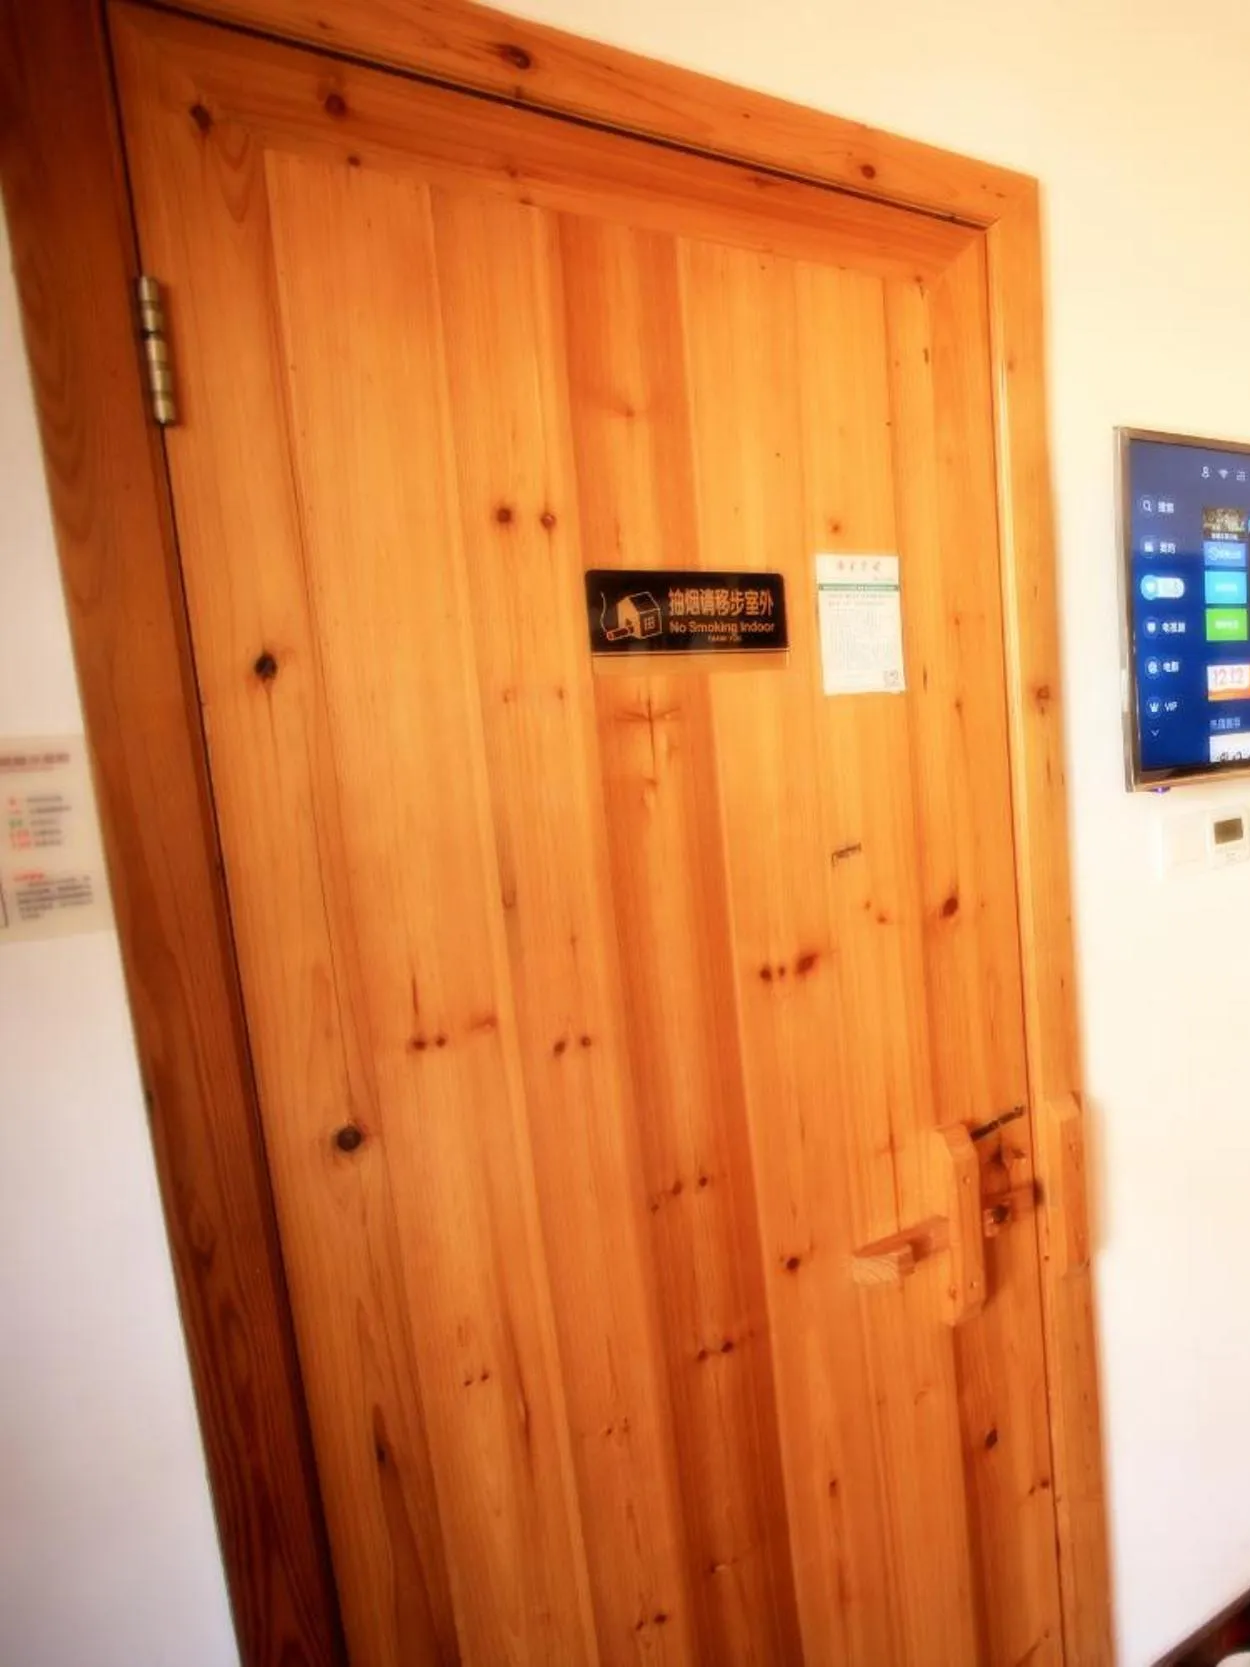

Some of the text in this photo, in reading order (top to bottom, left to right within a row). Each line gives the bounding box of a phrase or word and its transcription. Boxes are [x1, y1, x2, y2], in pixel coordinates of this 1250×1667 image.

[668, 587, 774, 617] 抽烟请移步室外
[669, 621, 775, 634] No Smoking Indoor
